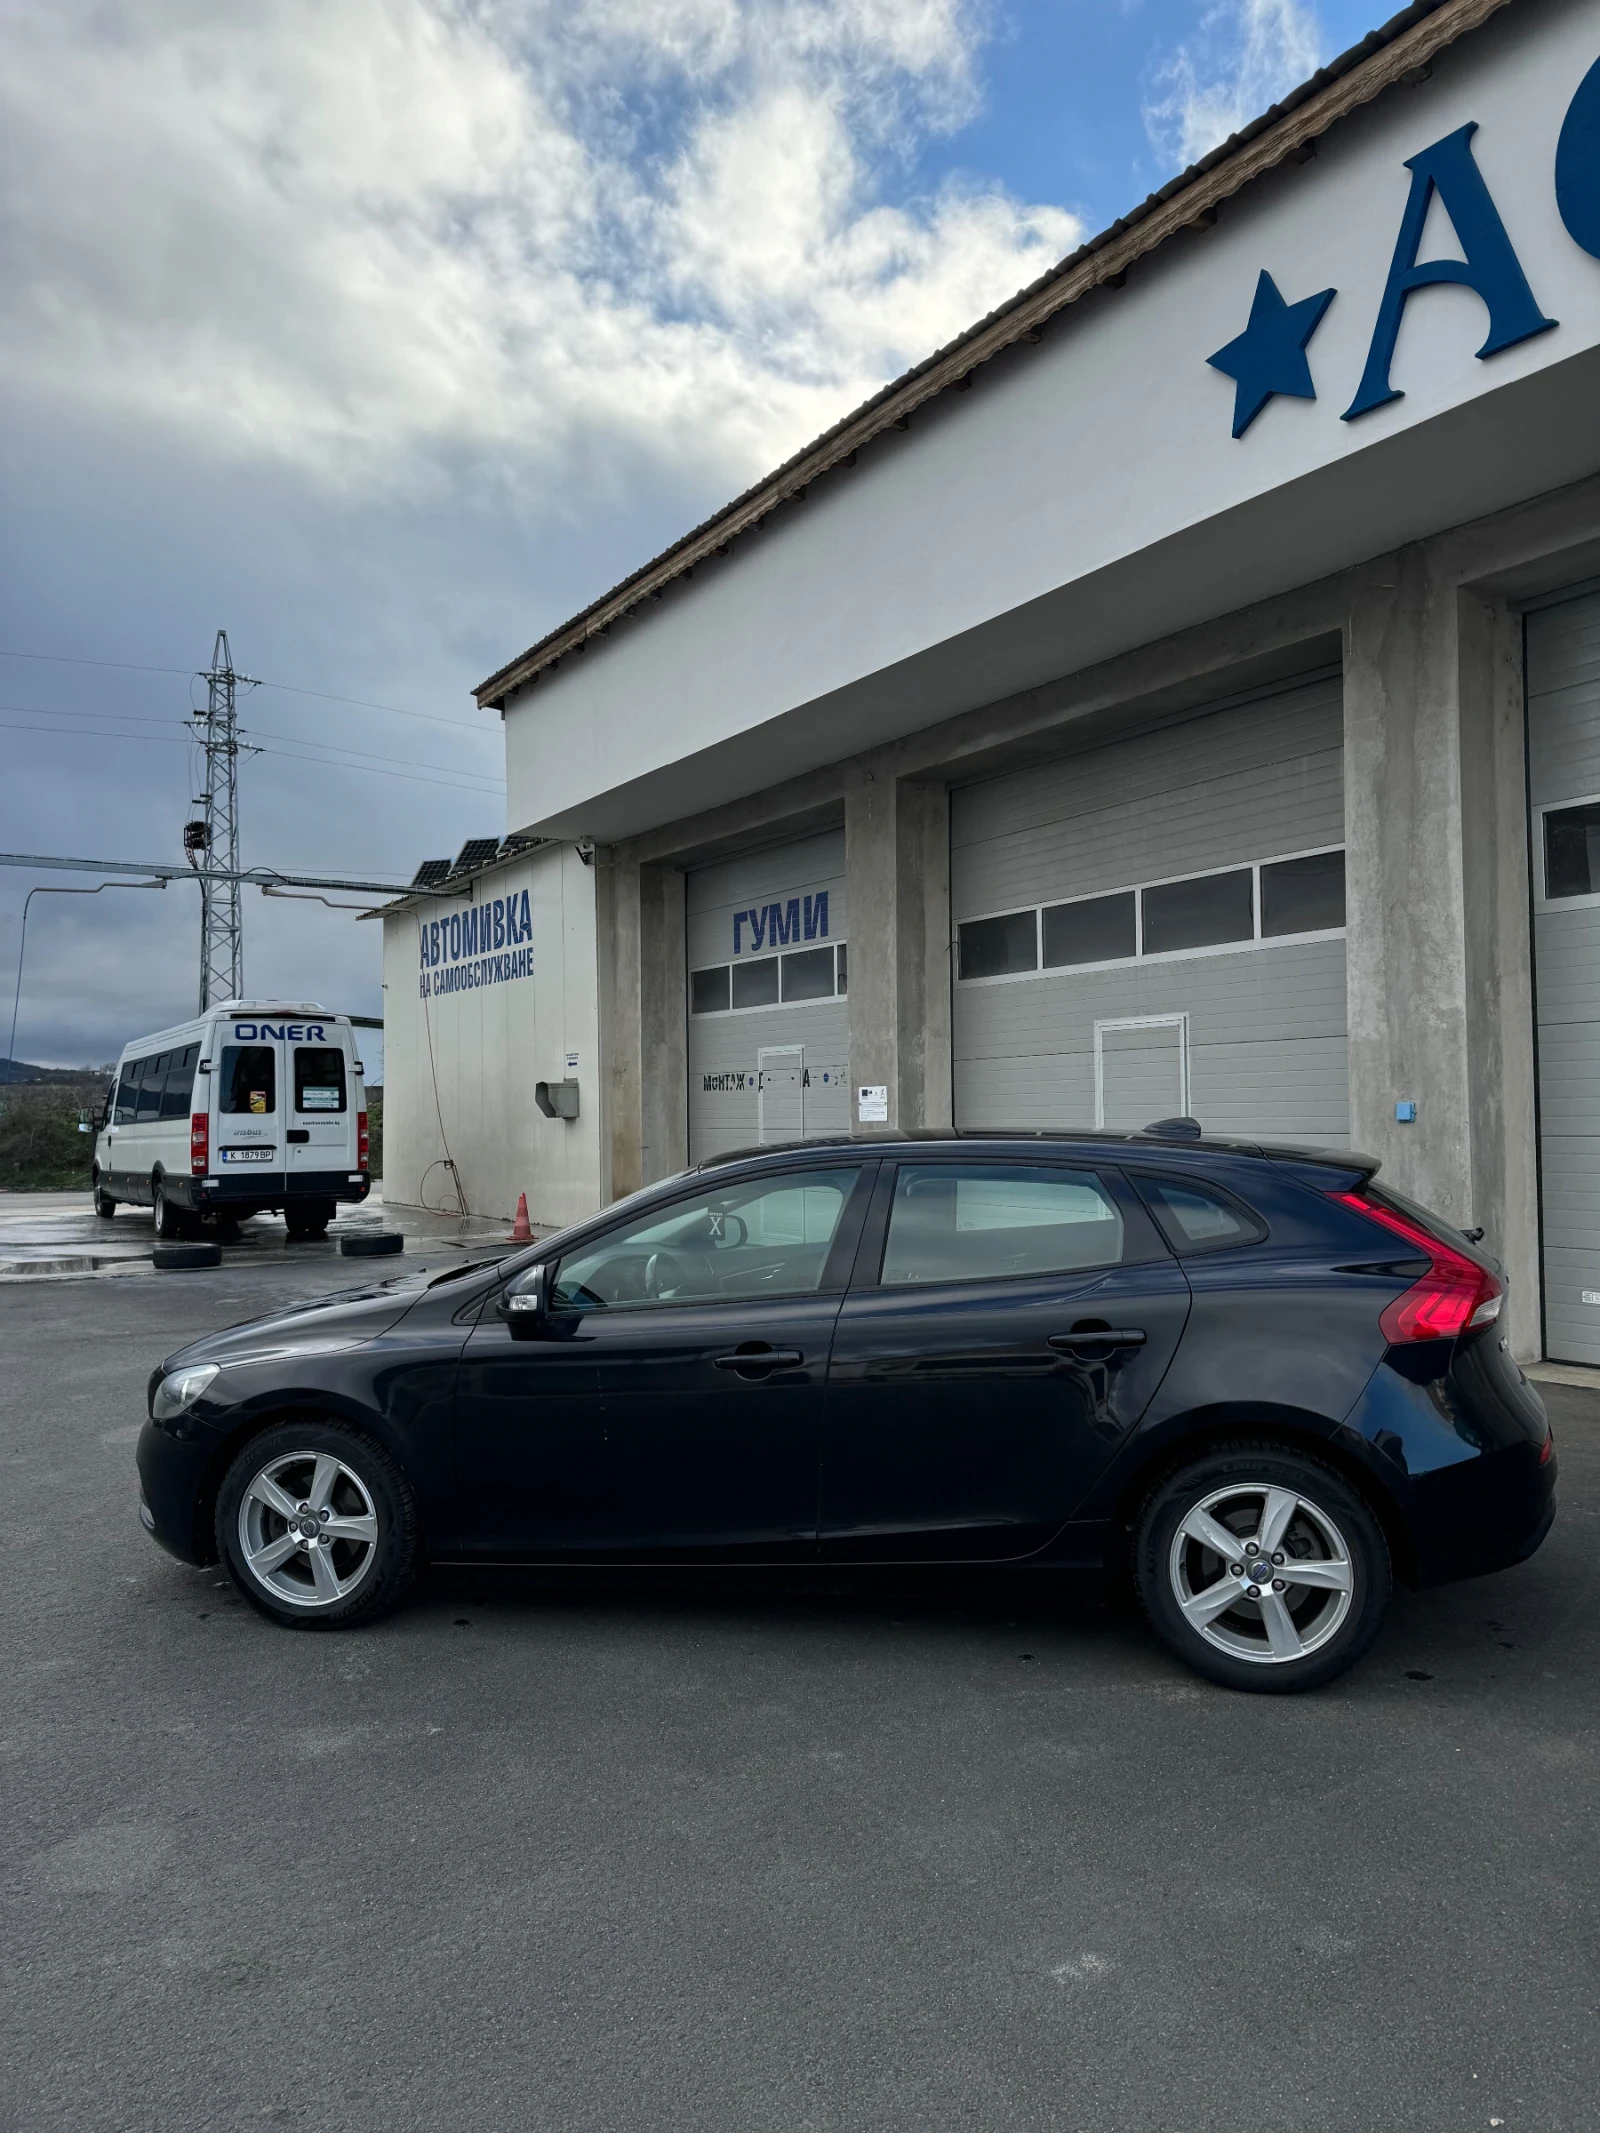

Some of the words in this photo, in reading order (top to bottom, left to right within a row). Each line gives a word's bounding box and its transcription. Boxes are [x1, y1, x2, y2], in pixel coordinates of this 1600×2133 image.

[420, 889, 533, 969] АВТОМИВКА
[733, 891, 829, 954] ГУМИ
[420, 972, 431, 999] НА
[434, 947, 533, 996] САМООБСЛУЖВАНЕ
[235, 1024, 327, 1041] ONER
[709, 1216, 722, 1235] X
